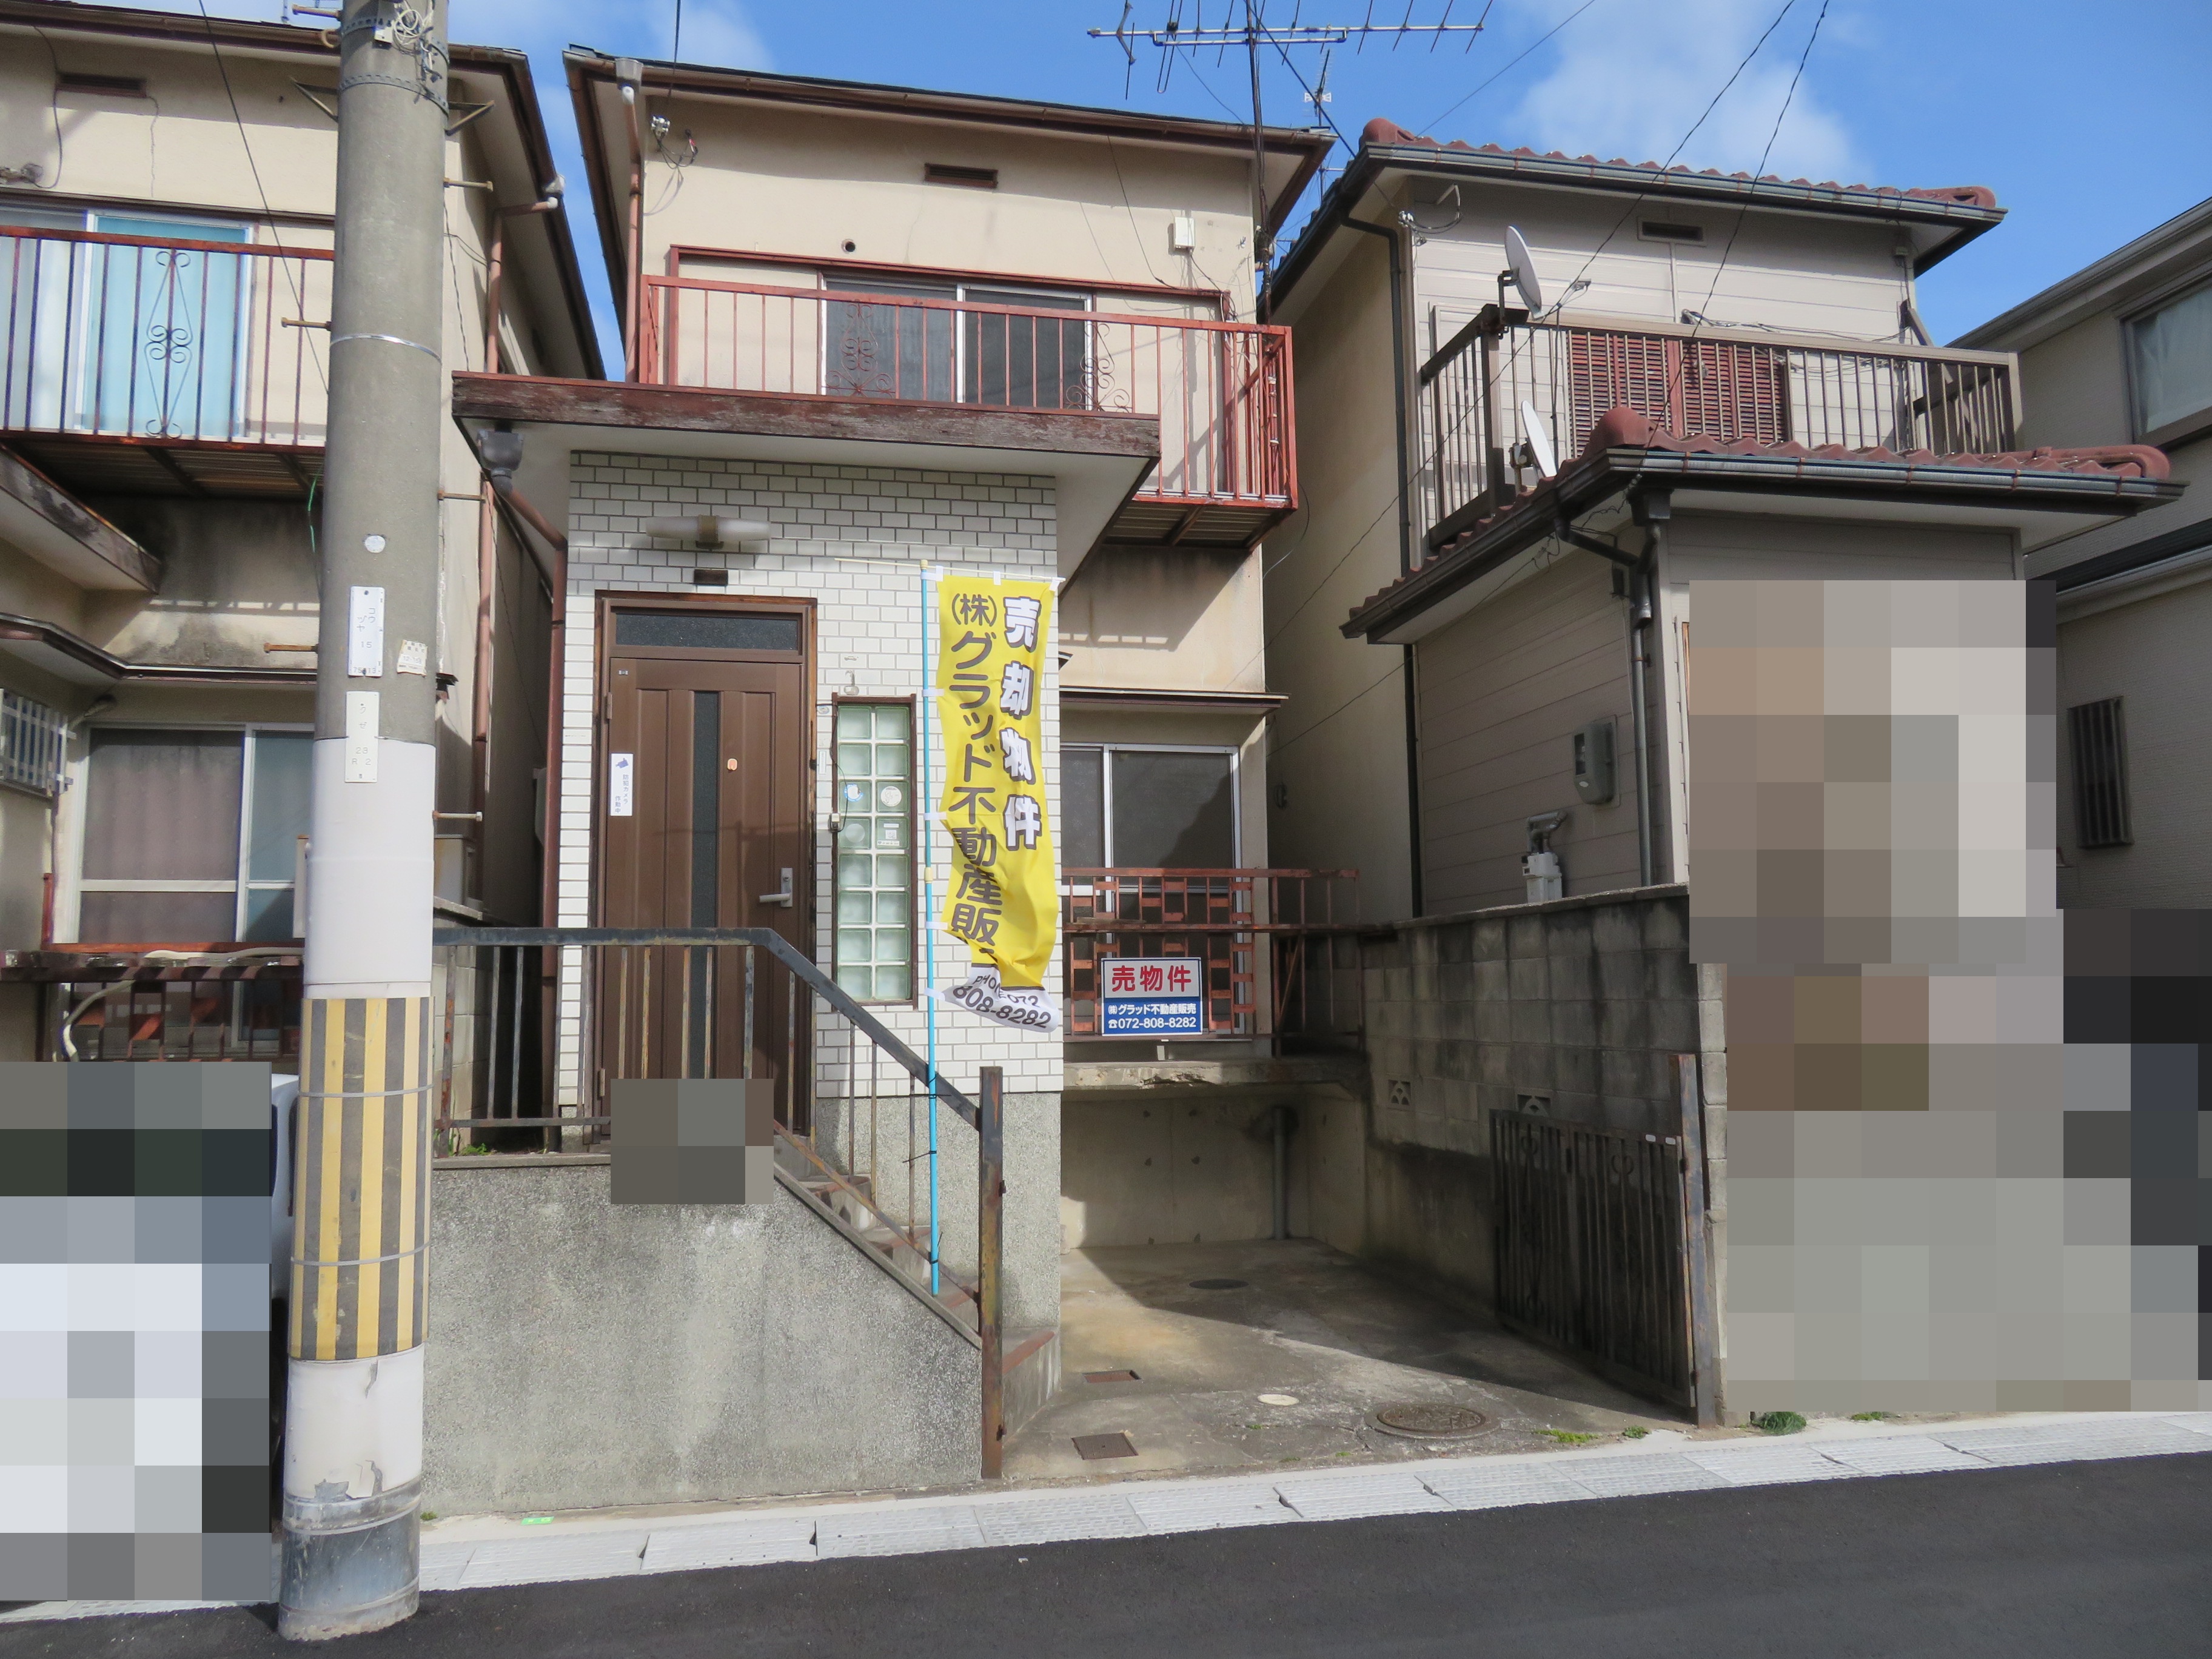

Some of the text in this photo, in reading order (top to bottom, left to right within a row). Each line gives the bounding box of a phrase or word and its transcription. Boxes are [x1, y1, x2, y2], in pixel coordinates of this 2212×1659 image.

[367, 608, 376, 623] コウ
[999, 596, 1042, 851] 売却物件
[948, 593, 1002, 962] (株)グラッド不動産販
[1111, 965, 1192, 993] 売物件
[953, 985, 1052, 1029] 808-8282
[1118, 1016, 1197, 1030] 072-808-8282
